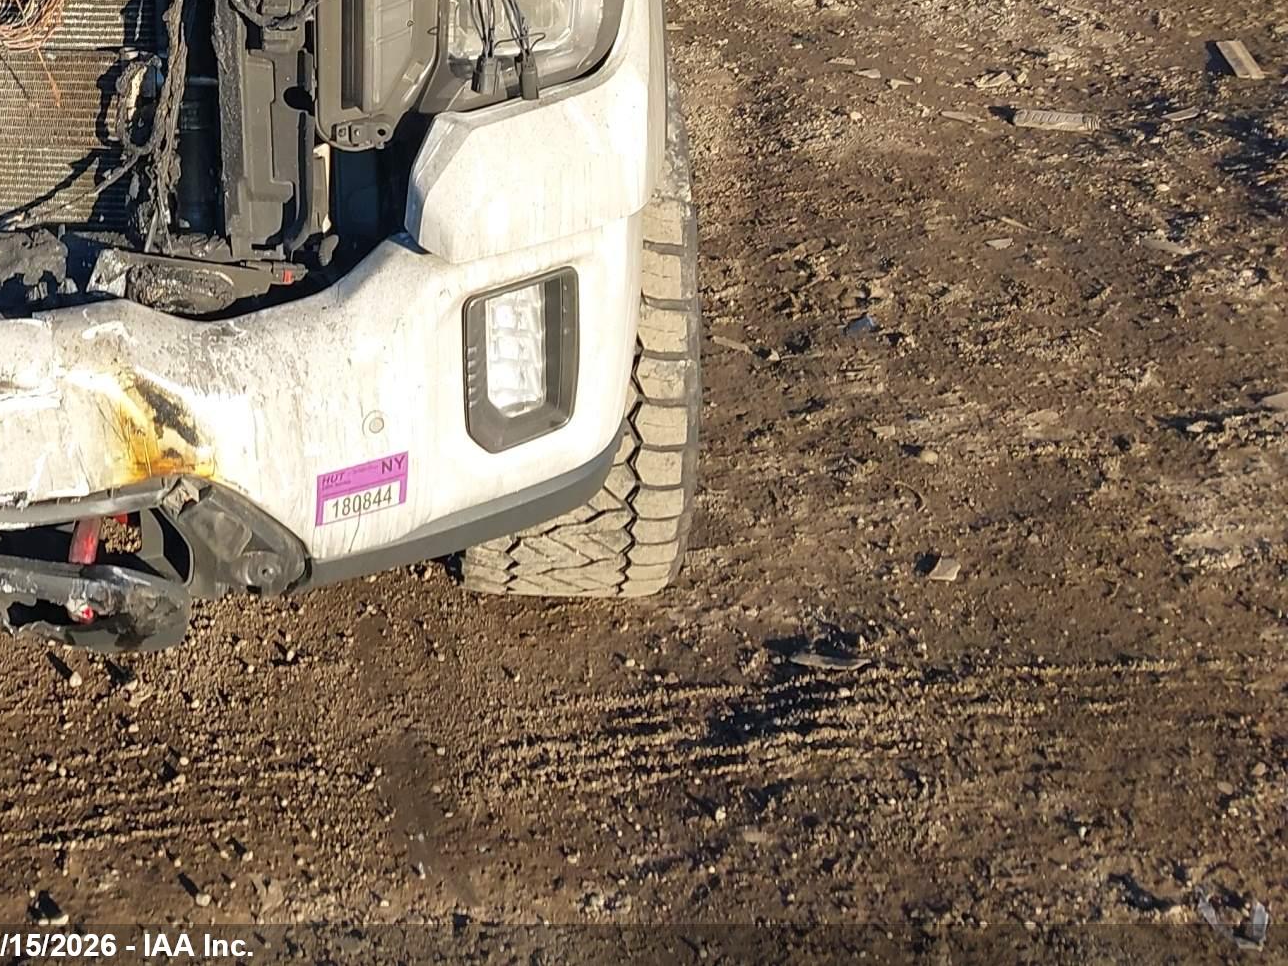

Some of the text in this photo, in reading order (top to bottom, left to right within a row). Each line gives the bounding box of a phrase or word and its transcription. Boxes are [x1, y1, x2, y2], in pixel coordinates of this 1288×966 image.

[321, 472, 345, 485] HUT
[381, 455, 406, 475] NY
[332, 485, 392, 518] 180844
